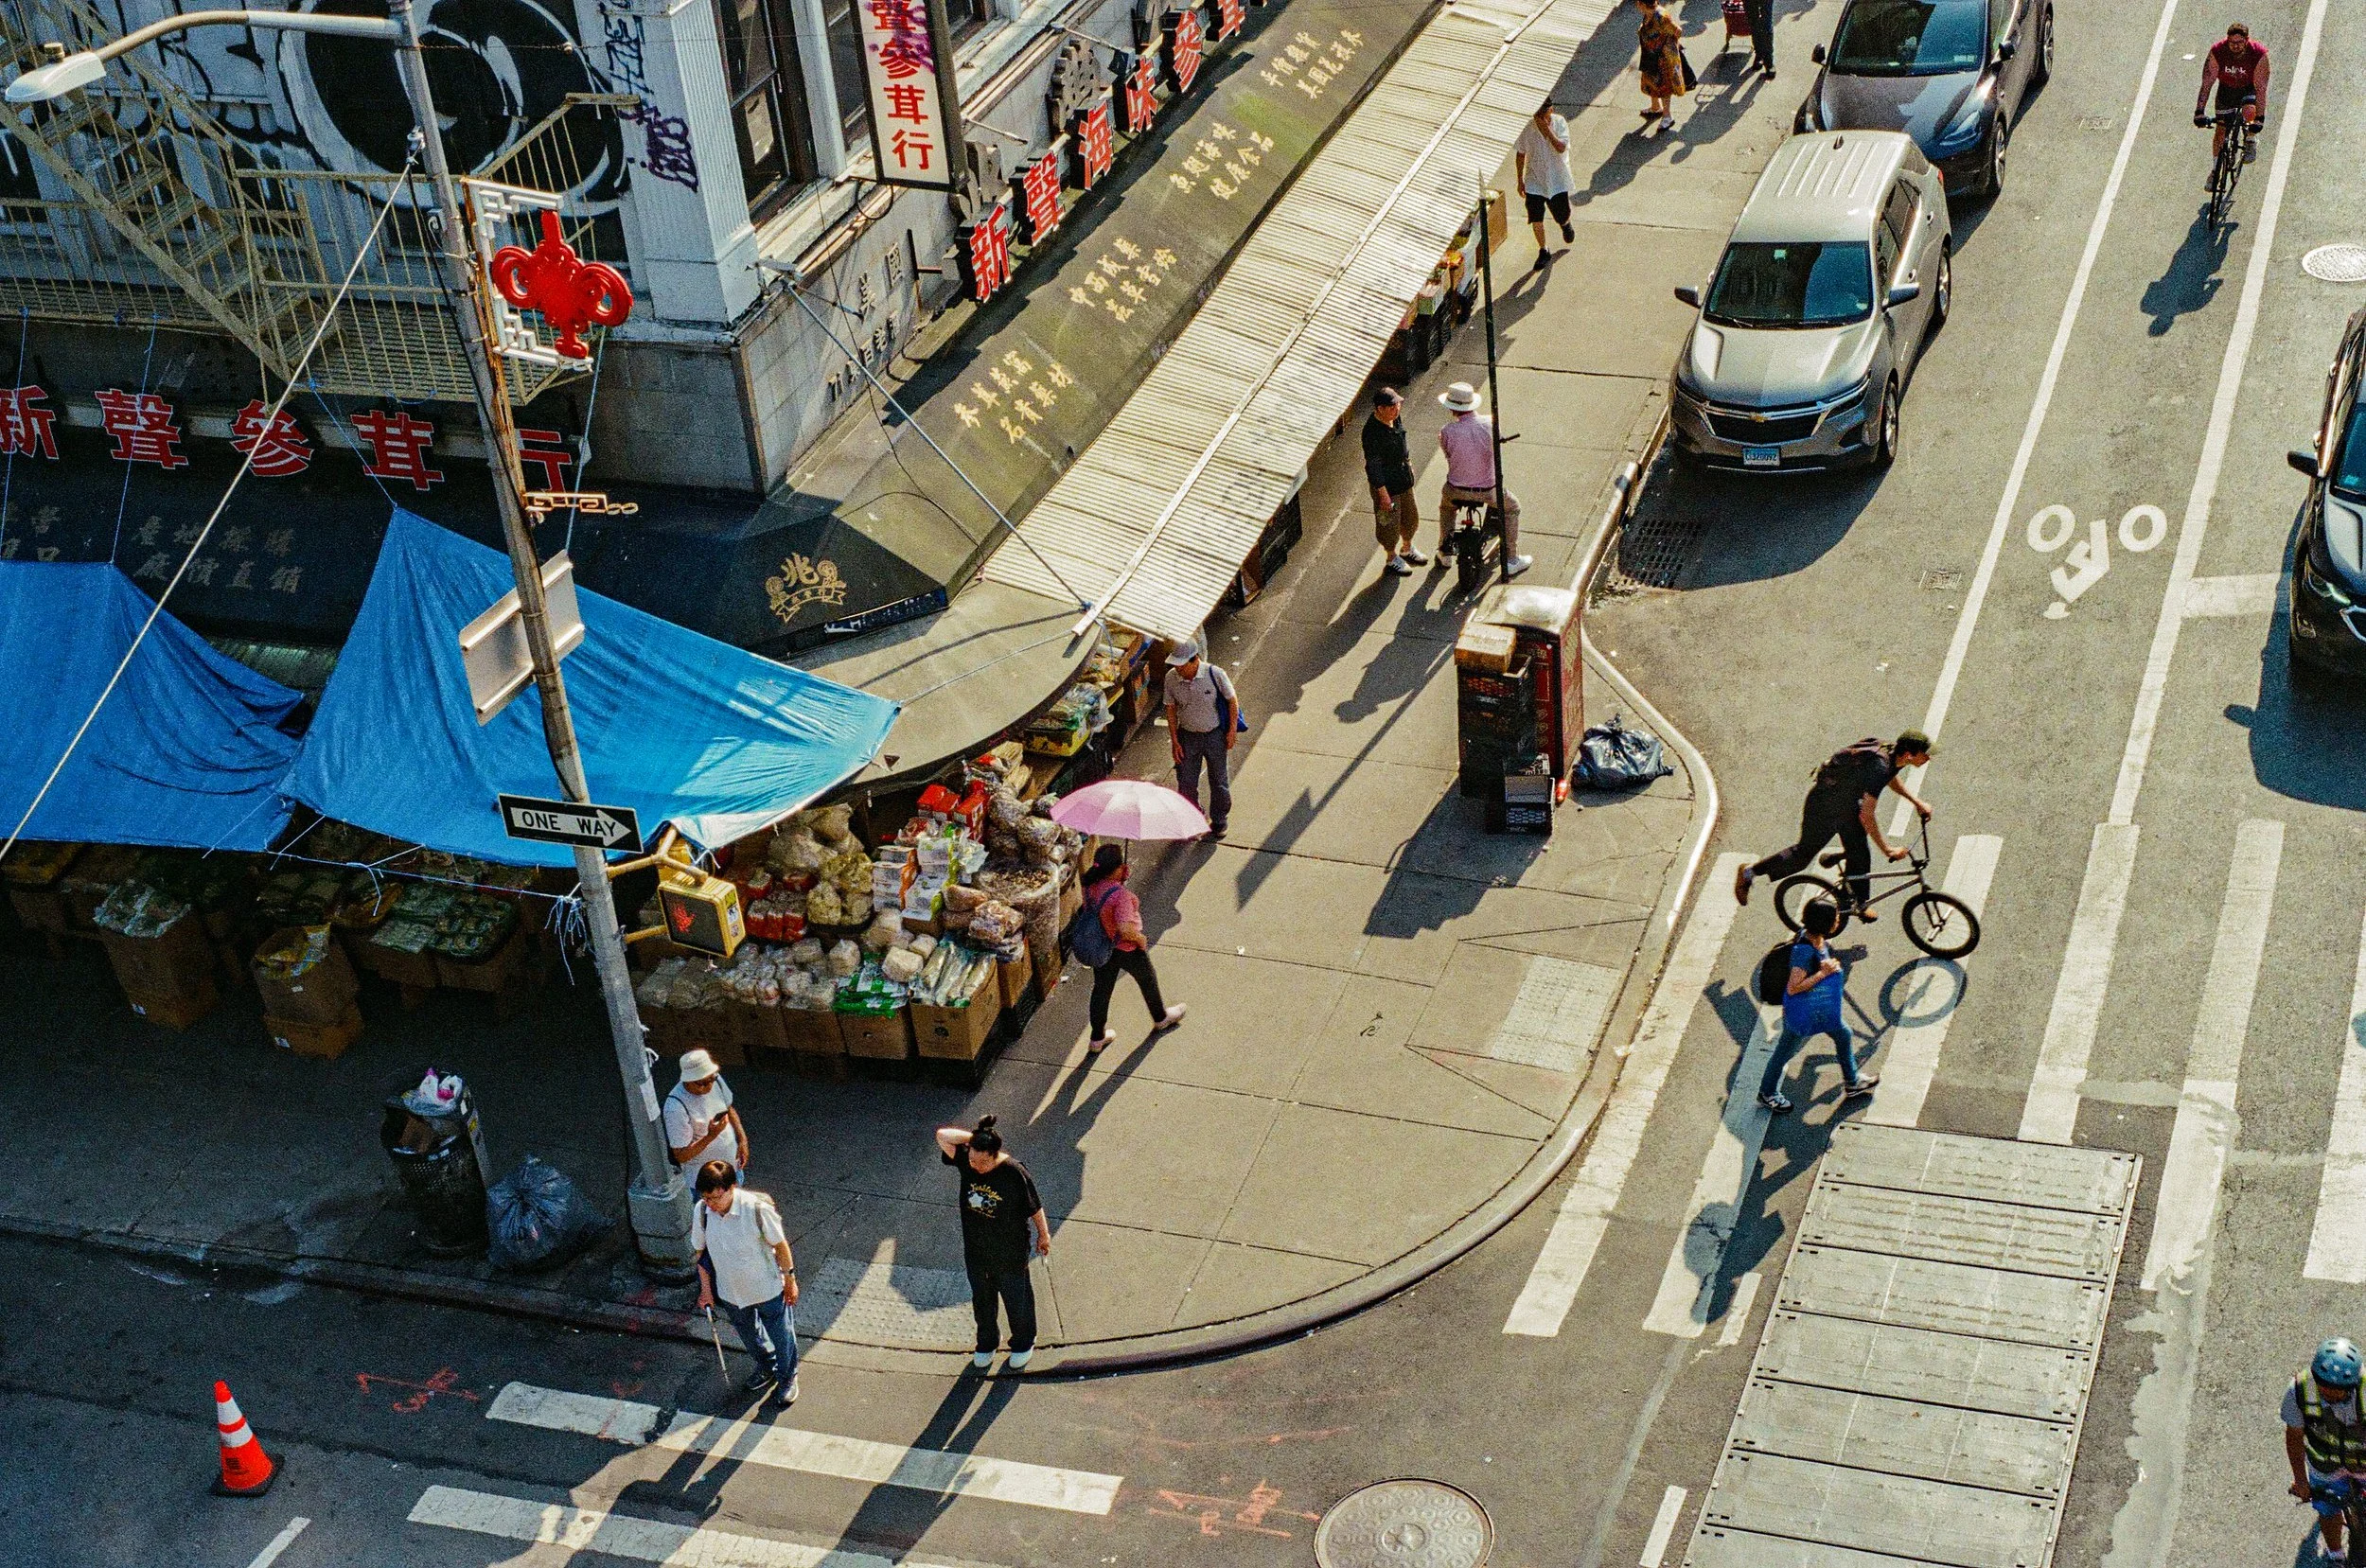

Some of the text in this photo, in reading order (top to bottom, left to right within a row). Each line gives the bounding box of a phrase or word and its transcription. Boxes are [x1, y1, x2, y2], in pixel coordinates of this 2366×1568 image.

[969, 0, 1268, 304] 新聲海味參茸
[1209, 131, 1275, 201] 健康食品
[999, 363, 1074, 445] 名貴藥材
[521, 811, 616, 837] ONE WAY
